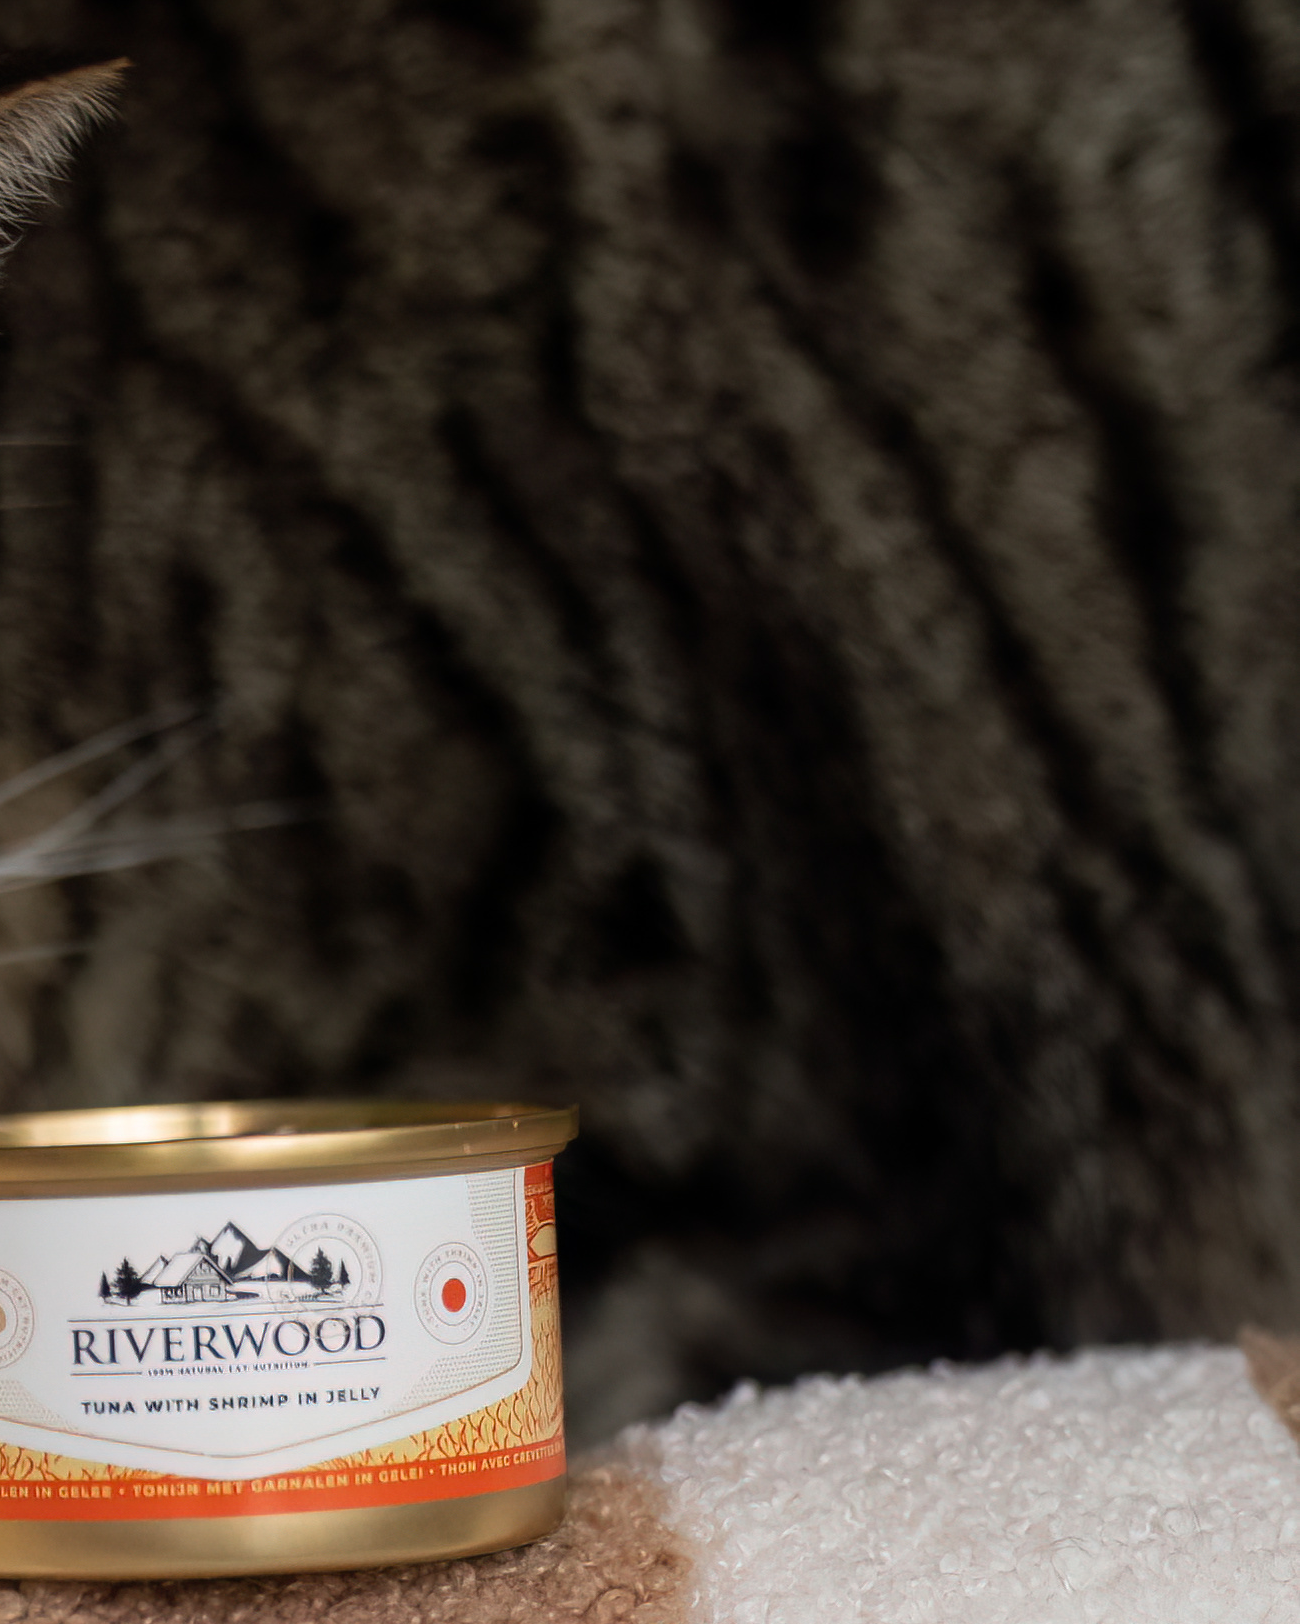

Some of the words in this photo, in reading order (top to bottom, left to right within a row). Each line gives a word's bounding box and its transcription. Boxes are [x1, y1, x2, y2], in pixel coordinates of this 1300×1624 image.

[71, 1314, 386, 1366] RIVERWOOD
[81, 1400, 136, 1415] TUNA
[145, 1399, 200, 1414] WITH
[208, 1394, 289, 1411] SHRIMP
[297, 1392, 318, 1406] IN
[325, 1386, 381, 1404] JELLY
[35, 1484, 52, 1498] IN
[132, 1482, 199, 1498] TONIJN
[206, 1479, 244, 1496] MET
[251, 1475, 350, 1494] GARNALEN
[354, 1471, 373, 1486] IN
[378, 1466, 424, 1483] GELEI
[439, 1462, 477, 1477] THON
[481, 1453, 510, 1471] AVEC
